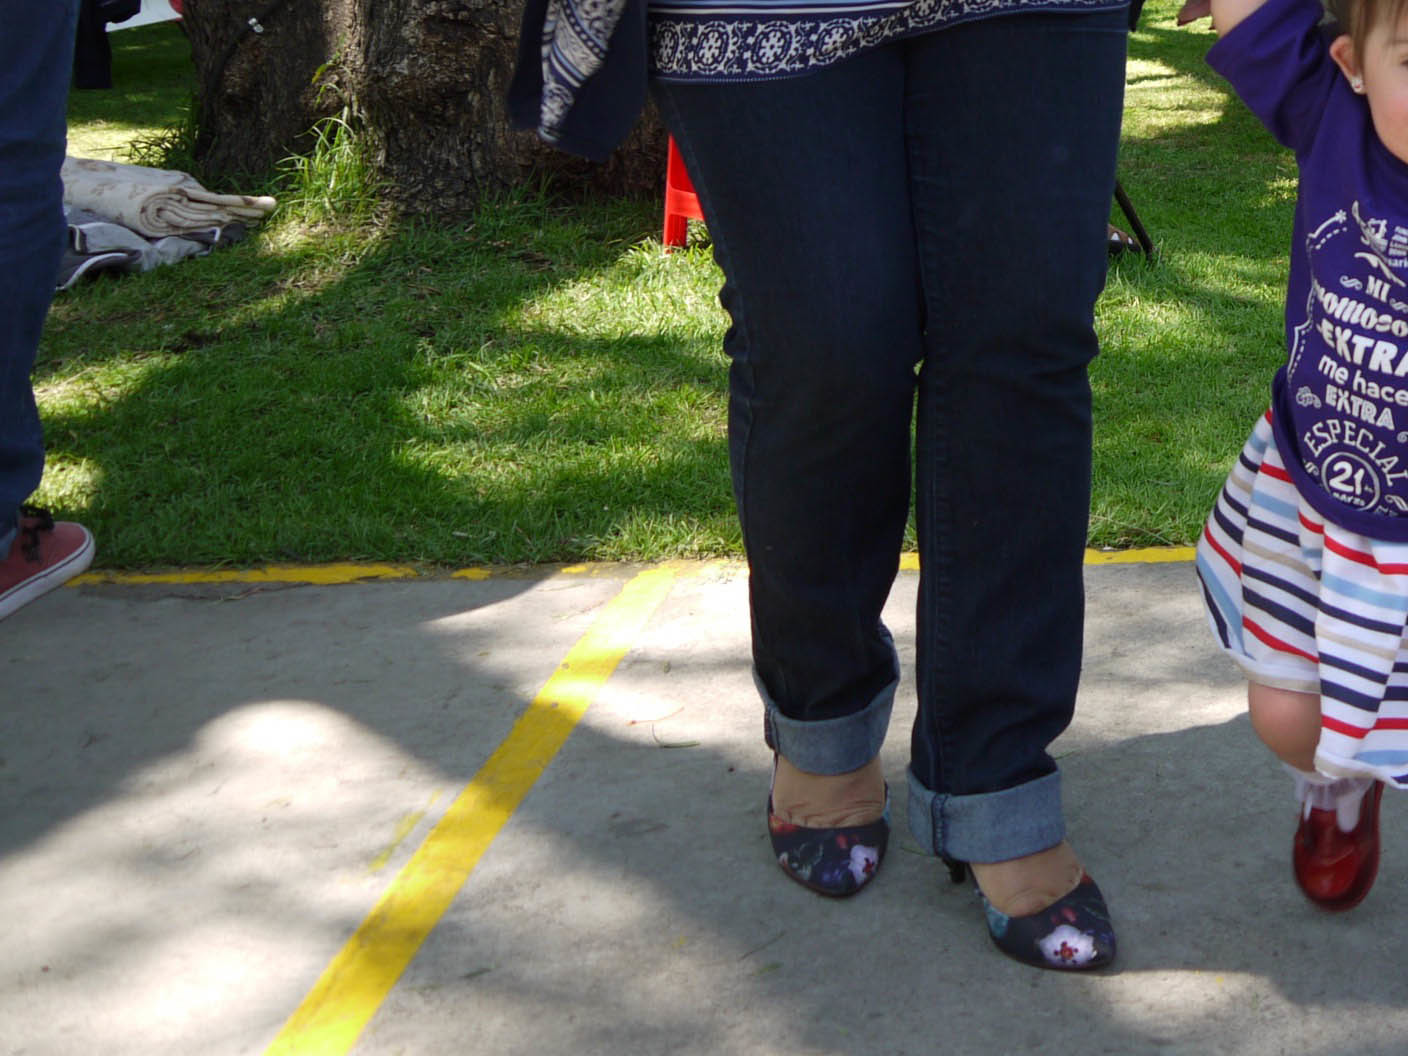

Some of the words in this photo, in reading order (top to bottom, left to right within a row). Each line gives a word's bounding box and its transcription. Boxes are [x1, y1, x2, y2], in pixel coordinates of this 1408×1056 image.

[1365, 275, 1391, 303] MI
[1318, 355, 1349, 385] me
[1325, 384, 1396, 431] EXTRA
[1304, 419, 1408, 487] ESPECIAL
[1329, 461, 1365, 495] 21
